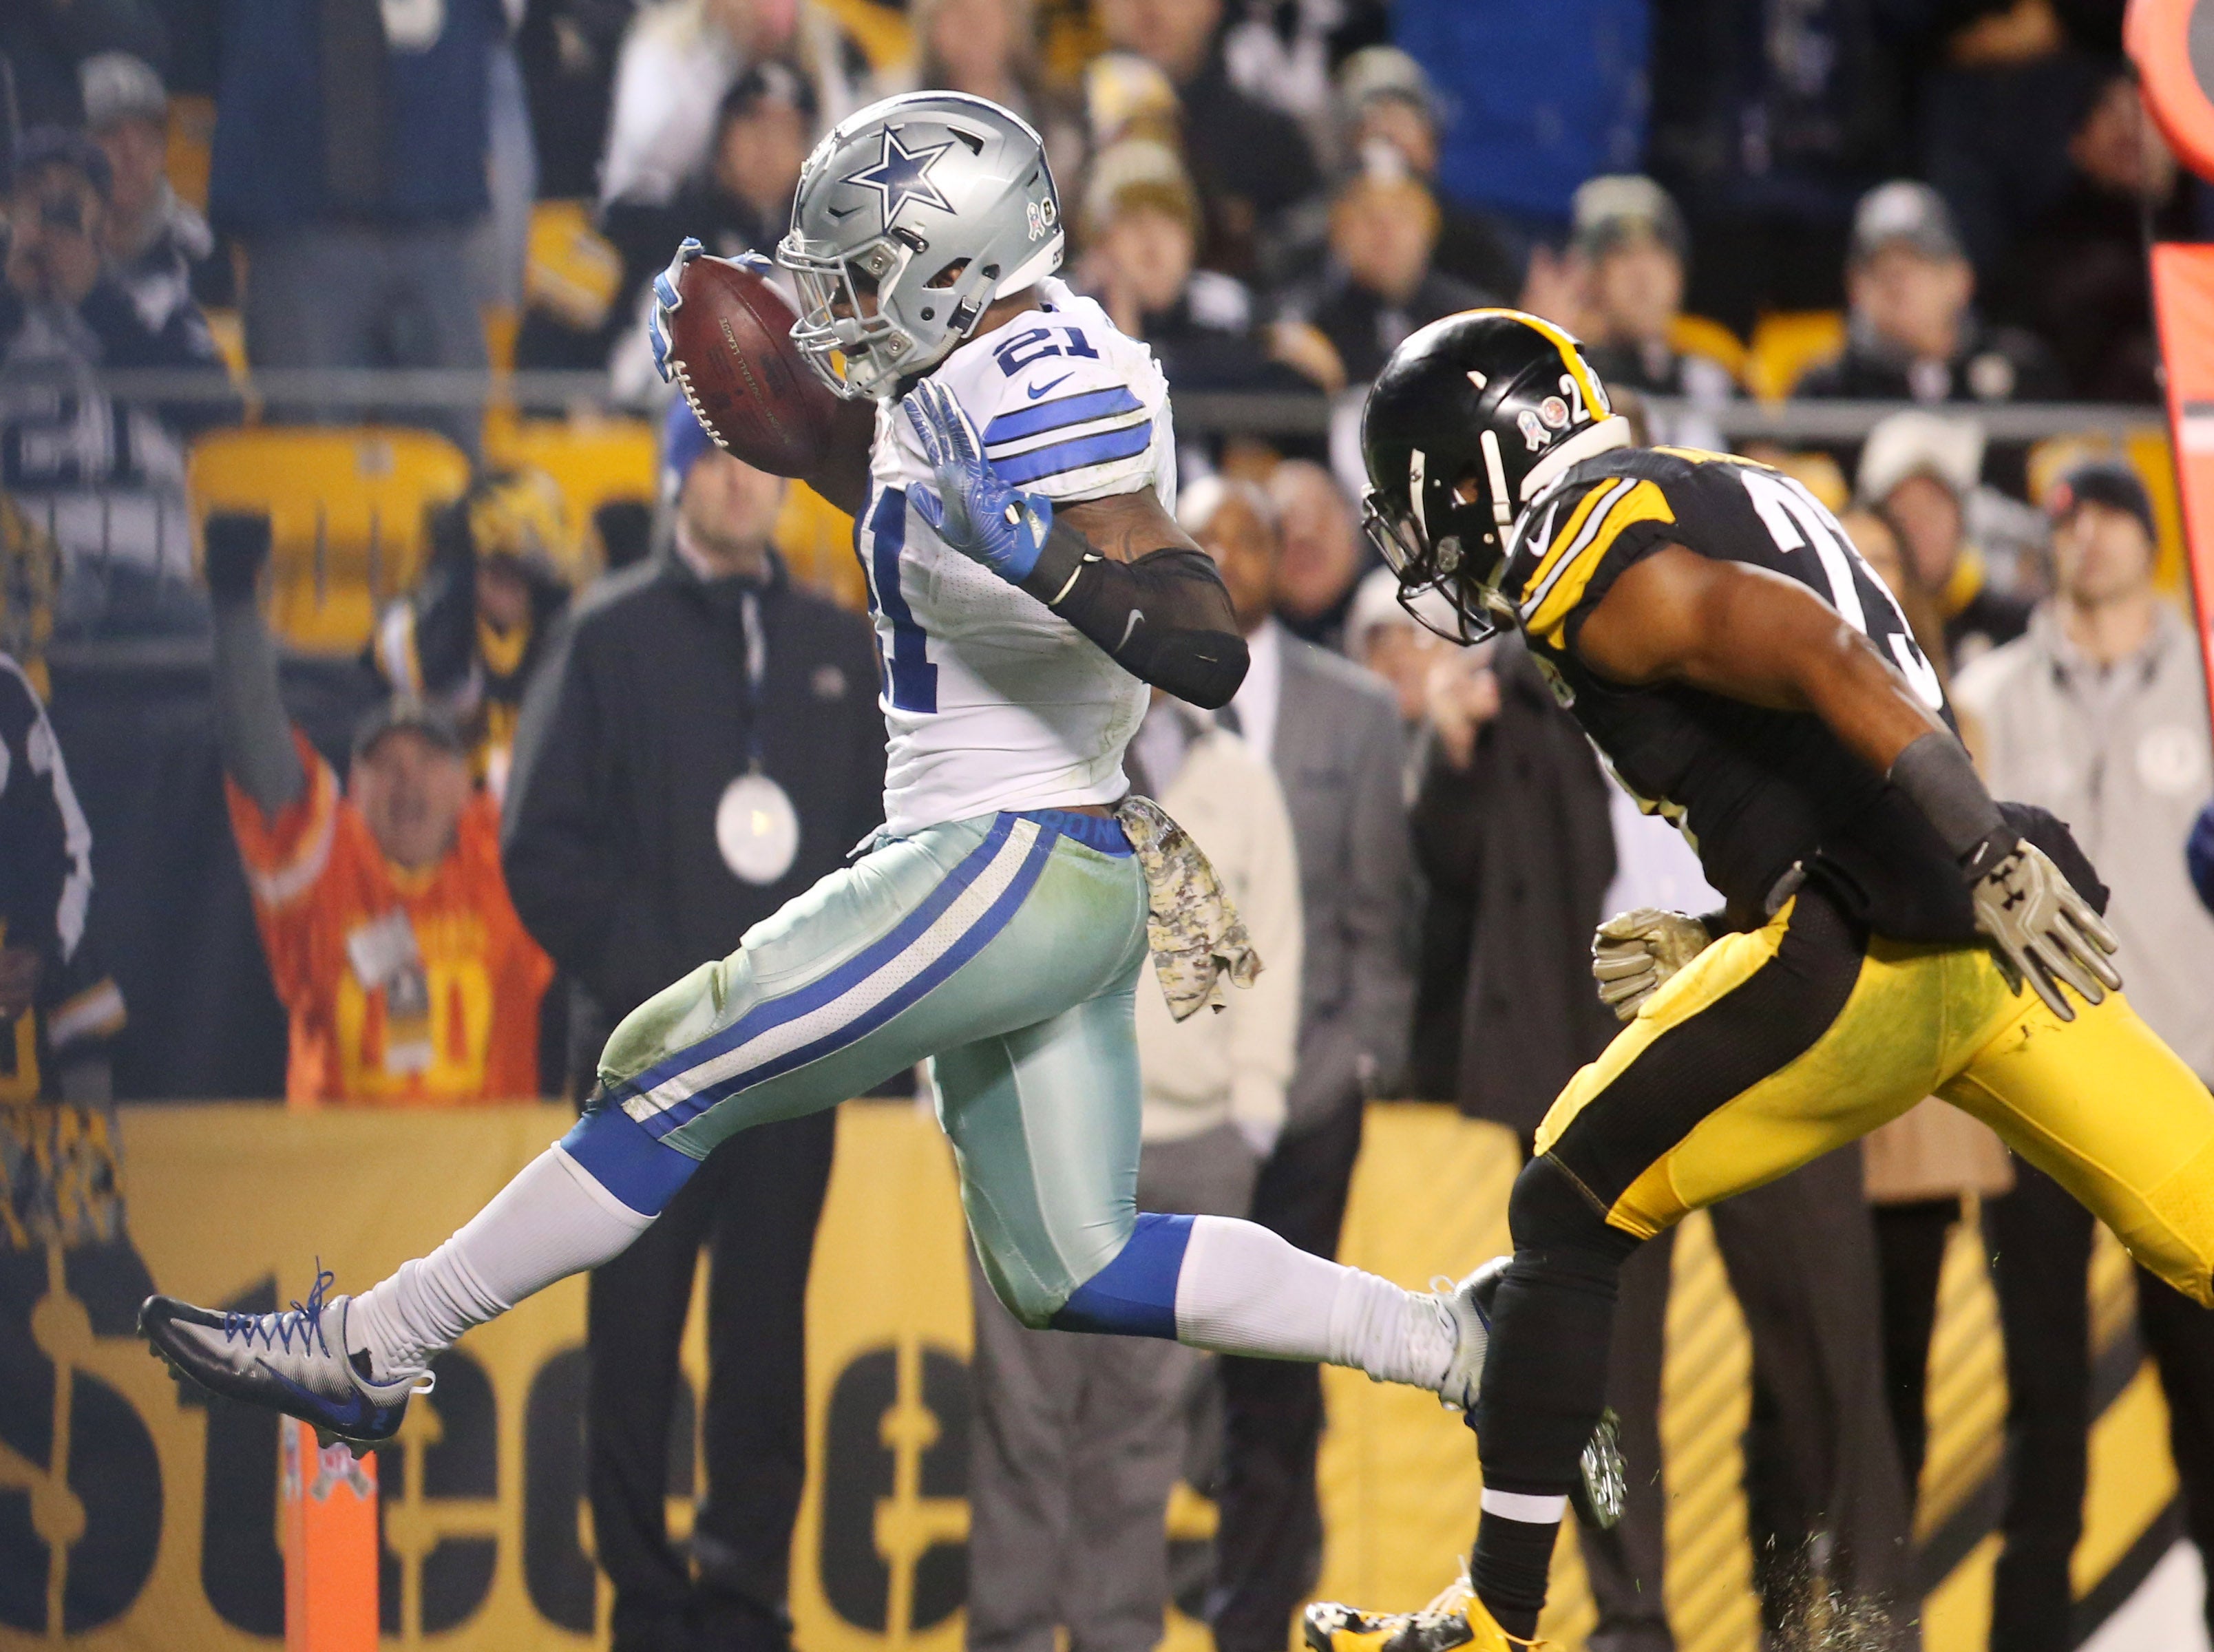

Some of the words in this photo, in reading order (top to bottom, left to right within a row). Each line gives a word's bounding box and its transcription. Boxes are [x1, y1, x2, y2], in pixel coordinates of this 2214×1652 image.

[718, 316, 741, 356] LEAGUE
[993, 326, 1099, 378] 21
[852, 476, 938, 713] 1
